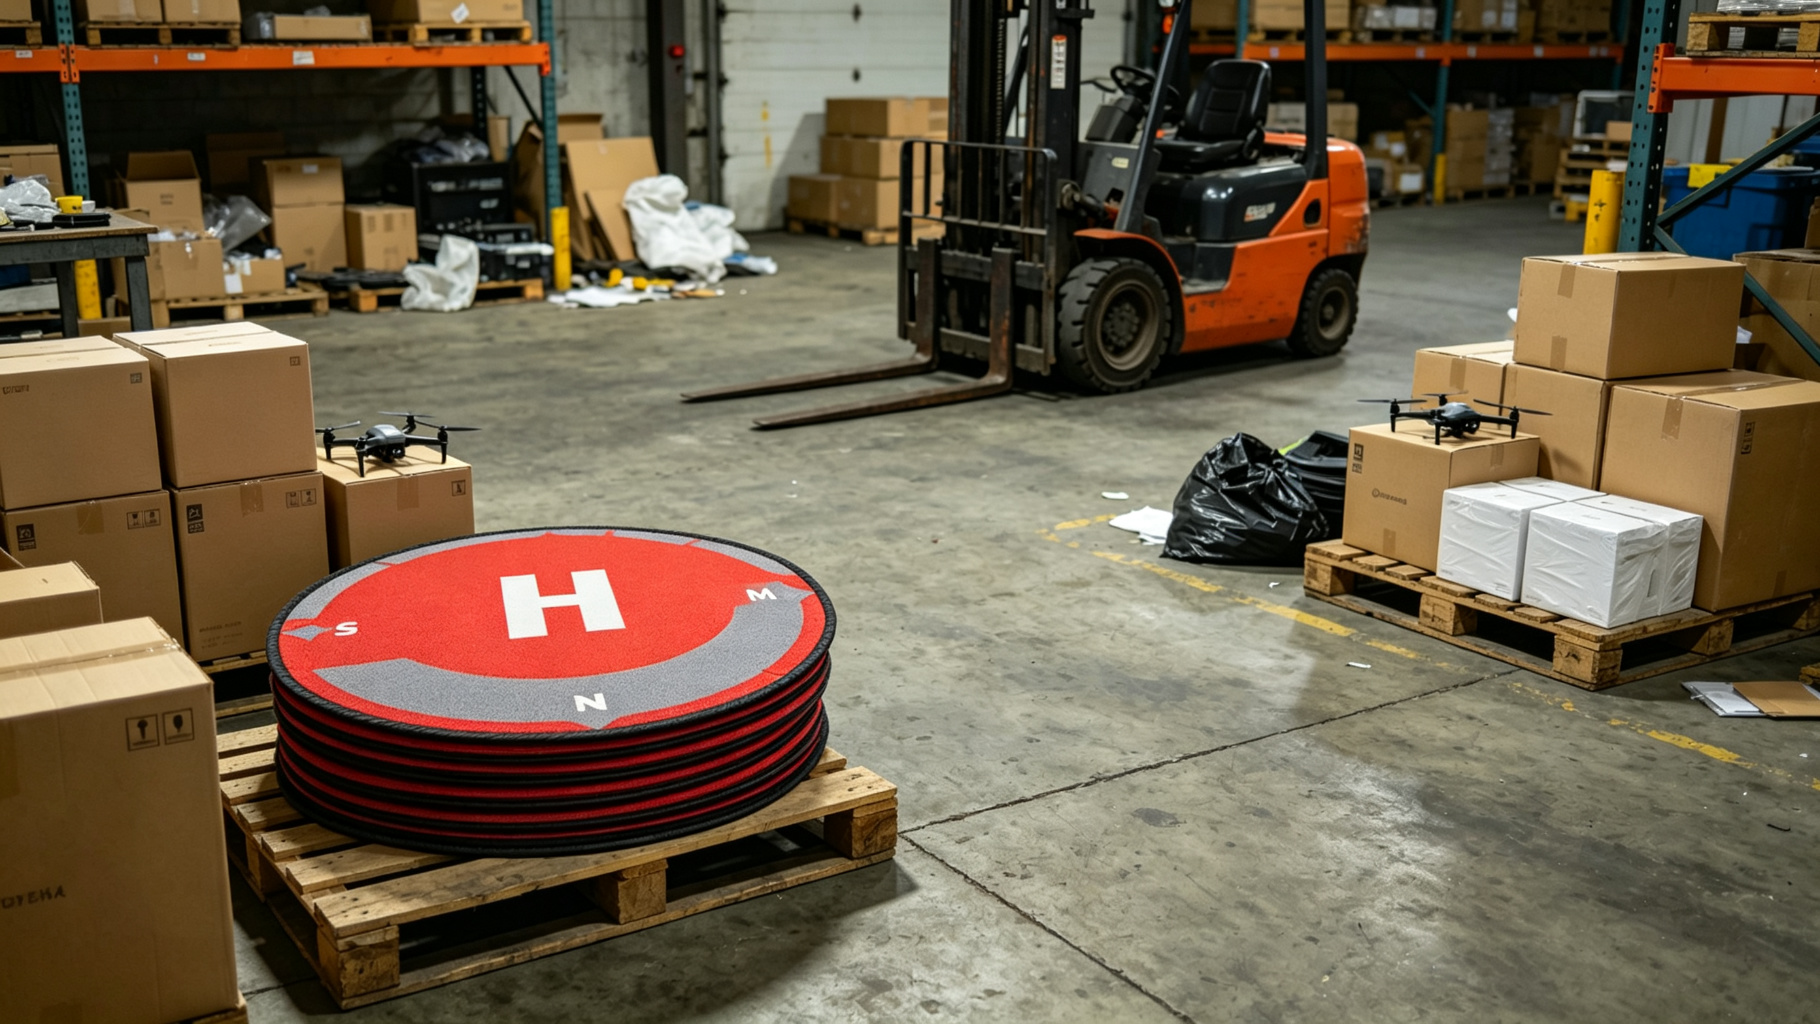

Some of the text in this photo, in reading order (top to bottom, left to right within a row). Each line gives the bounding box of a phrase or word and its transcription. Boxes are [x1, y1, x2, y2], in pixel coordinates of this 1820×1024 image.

[746, 587, 777, 601] M
[500, 569, 625, 639] H
[335, 621, 358, 637] S
[574, 693, 607, 712] N
